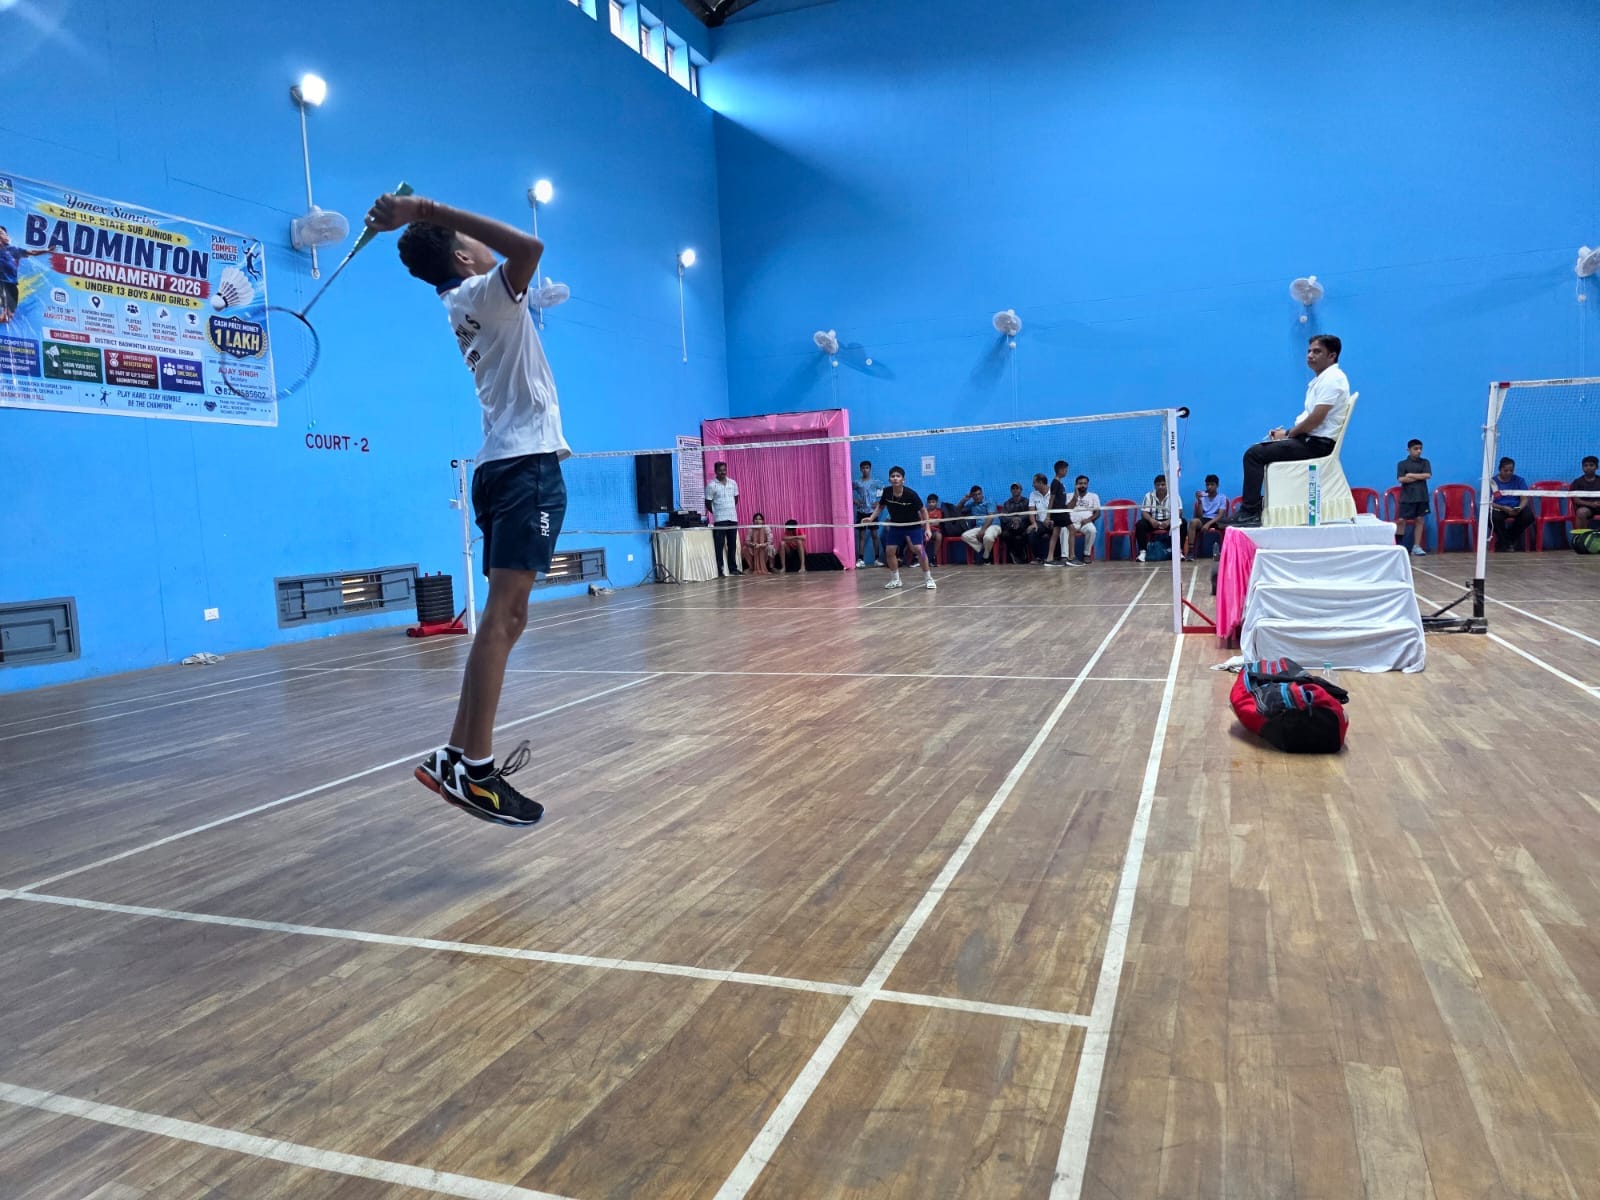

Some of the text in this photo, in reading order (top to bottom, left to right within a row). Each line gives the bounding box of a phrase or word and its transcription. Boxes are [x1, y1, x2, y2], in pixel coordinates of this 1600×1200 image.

[64, 193, 108, 214] Yonex
[60, 208, 76, 220] 2nd
[100, 218, 126, 231] STATE
[127, 224, 144, 234] SUB
[144, 228, 173, 242] JUNIOR
[26, 212, 208, 279] BADMINTON
[212, 243, 238, 254] COMPETE
[64, 256, 201, 296] TOURNAMENT 2026
[84, 280, 190, 308] UNDER 13 BOYS AND GIRLS
[214, 320, 259, 332] CASH PRIZE MONEY
[94, 337, 118, 346] DISTRICT
[118, 340, 146, 350] BADMINTON
[215, 328, 222, 346] 1
[226, 330, 260, 351] LAKH
[238, 369, 258, 378] SINGH
[117, 390, 130, 398] PLAY
[540, 511, 550, 537] RUN
